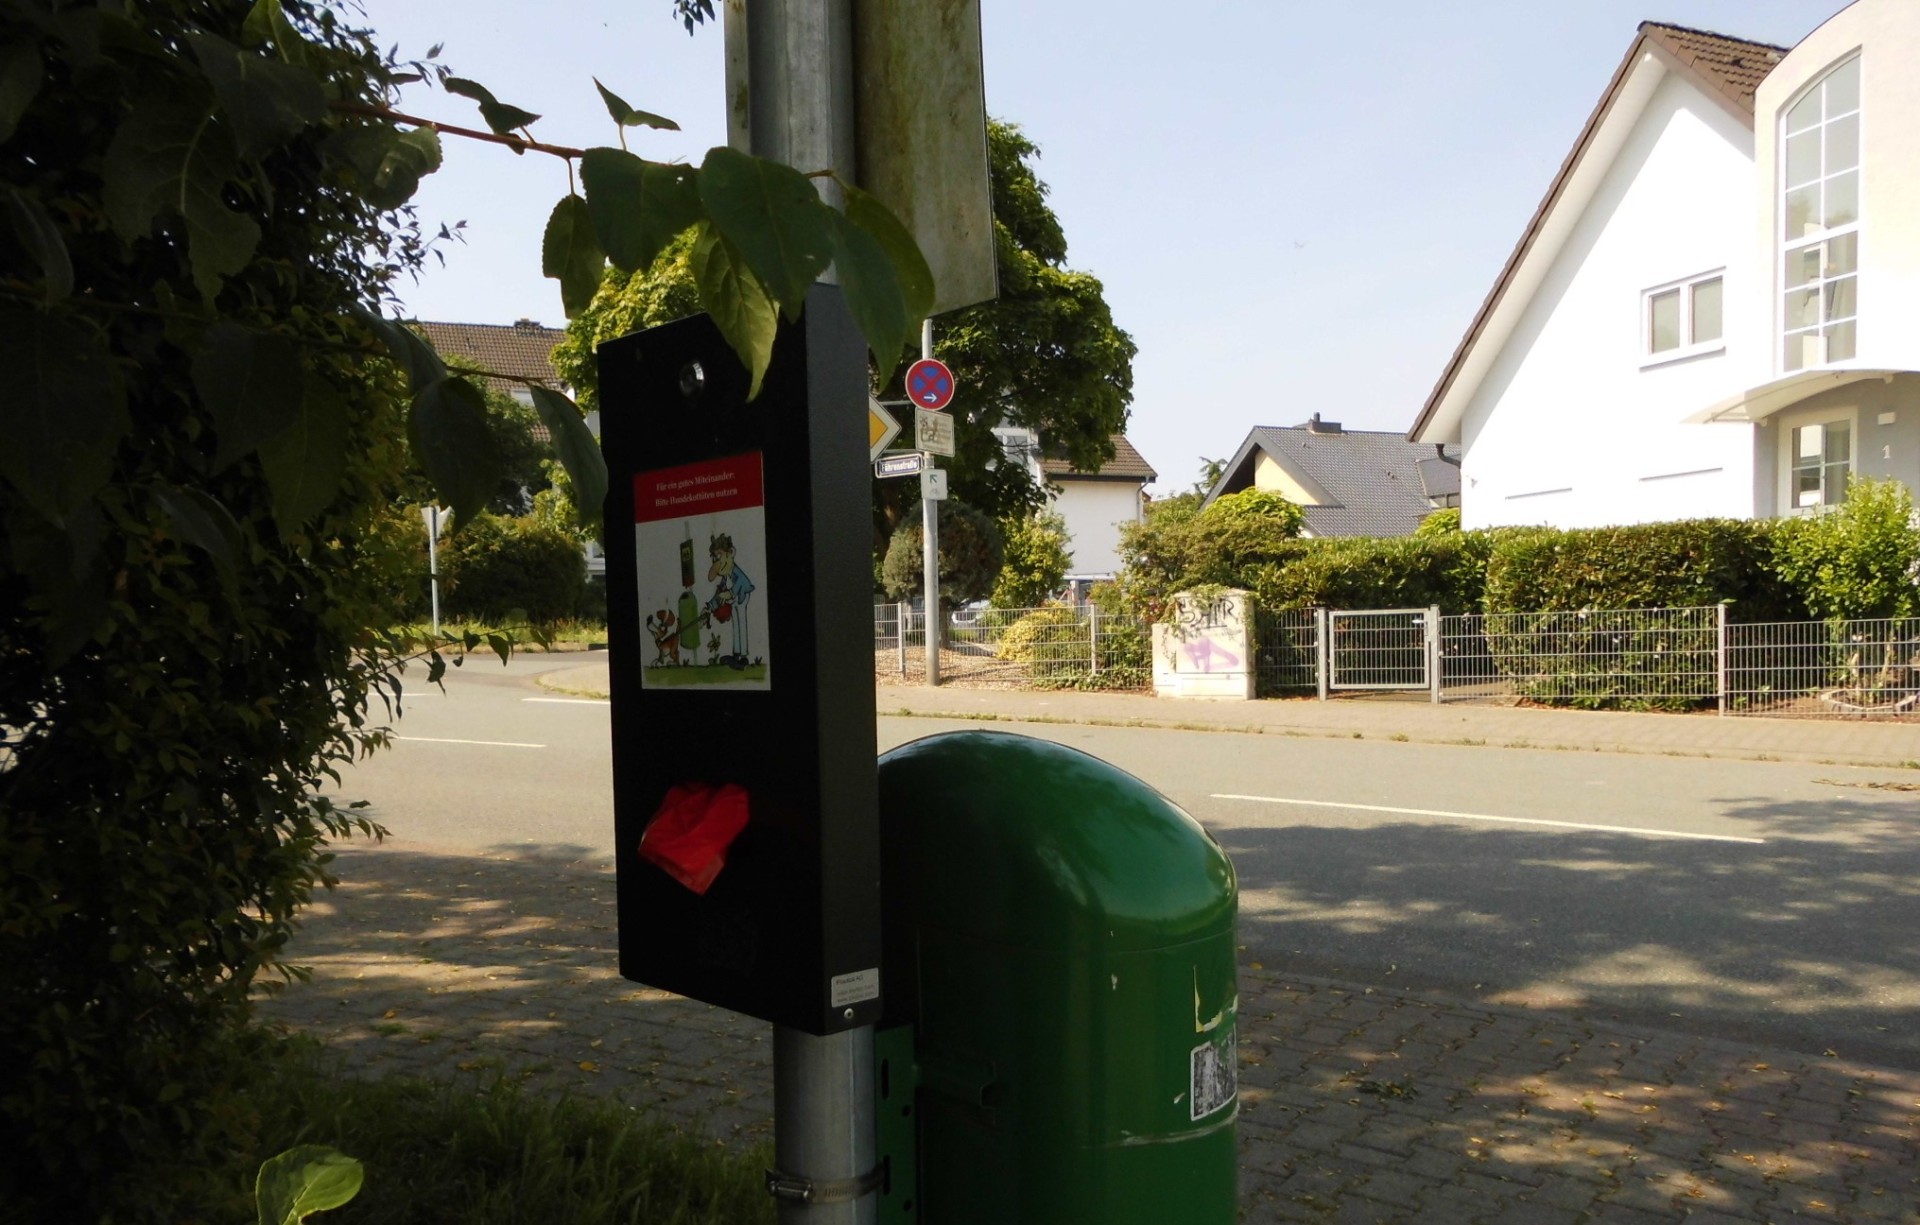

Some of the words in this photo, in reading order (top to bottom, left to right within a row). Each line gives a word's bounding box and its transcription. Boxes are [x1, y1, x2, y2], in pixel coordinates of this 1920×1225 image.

[1882, 444, 1891, 460] 1
[656, 482, 667, 492] Für
[667, 482, 677, 490] ein
[678, 480, 694, 489] gutes
[655, 498, 669, 507] Bitte
[716, 488, 738, 497] nutzen
